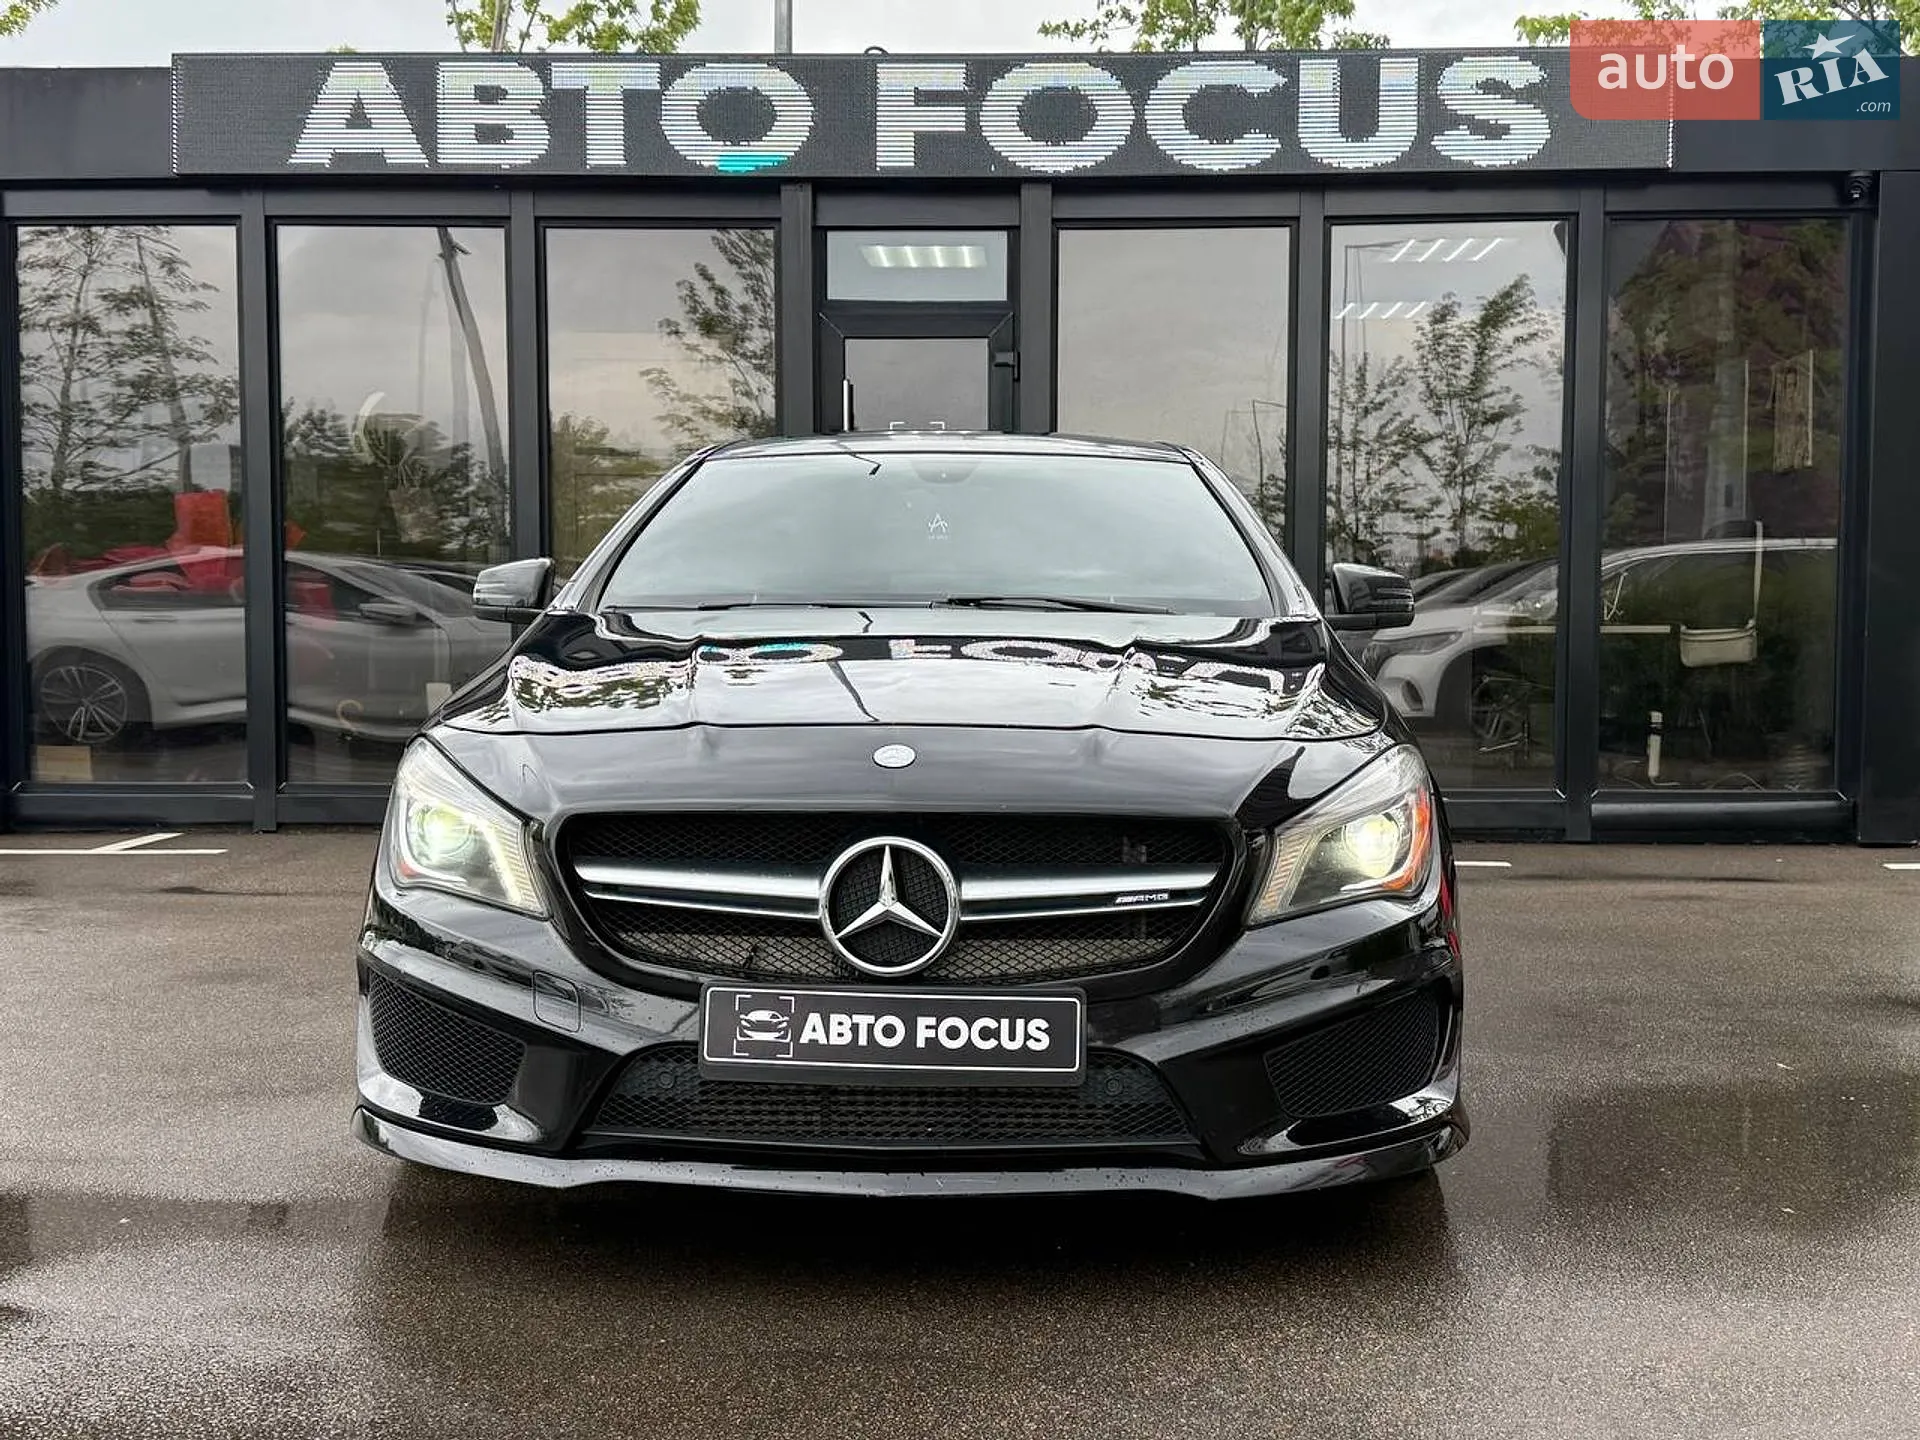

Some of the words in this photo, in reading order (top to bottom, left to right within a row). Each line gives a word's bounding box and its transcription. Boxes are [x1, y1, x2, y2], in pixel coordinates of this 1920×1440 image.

[287, 61, 814, 171] АВТО
[876, 57, 1554, 172] FOCUS
[800, 1012, 905, 1048] АВТО
[916, 1017, 1050, 1052] FOCUS
